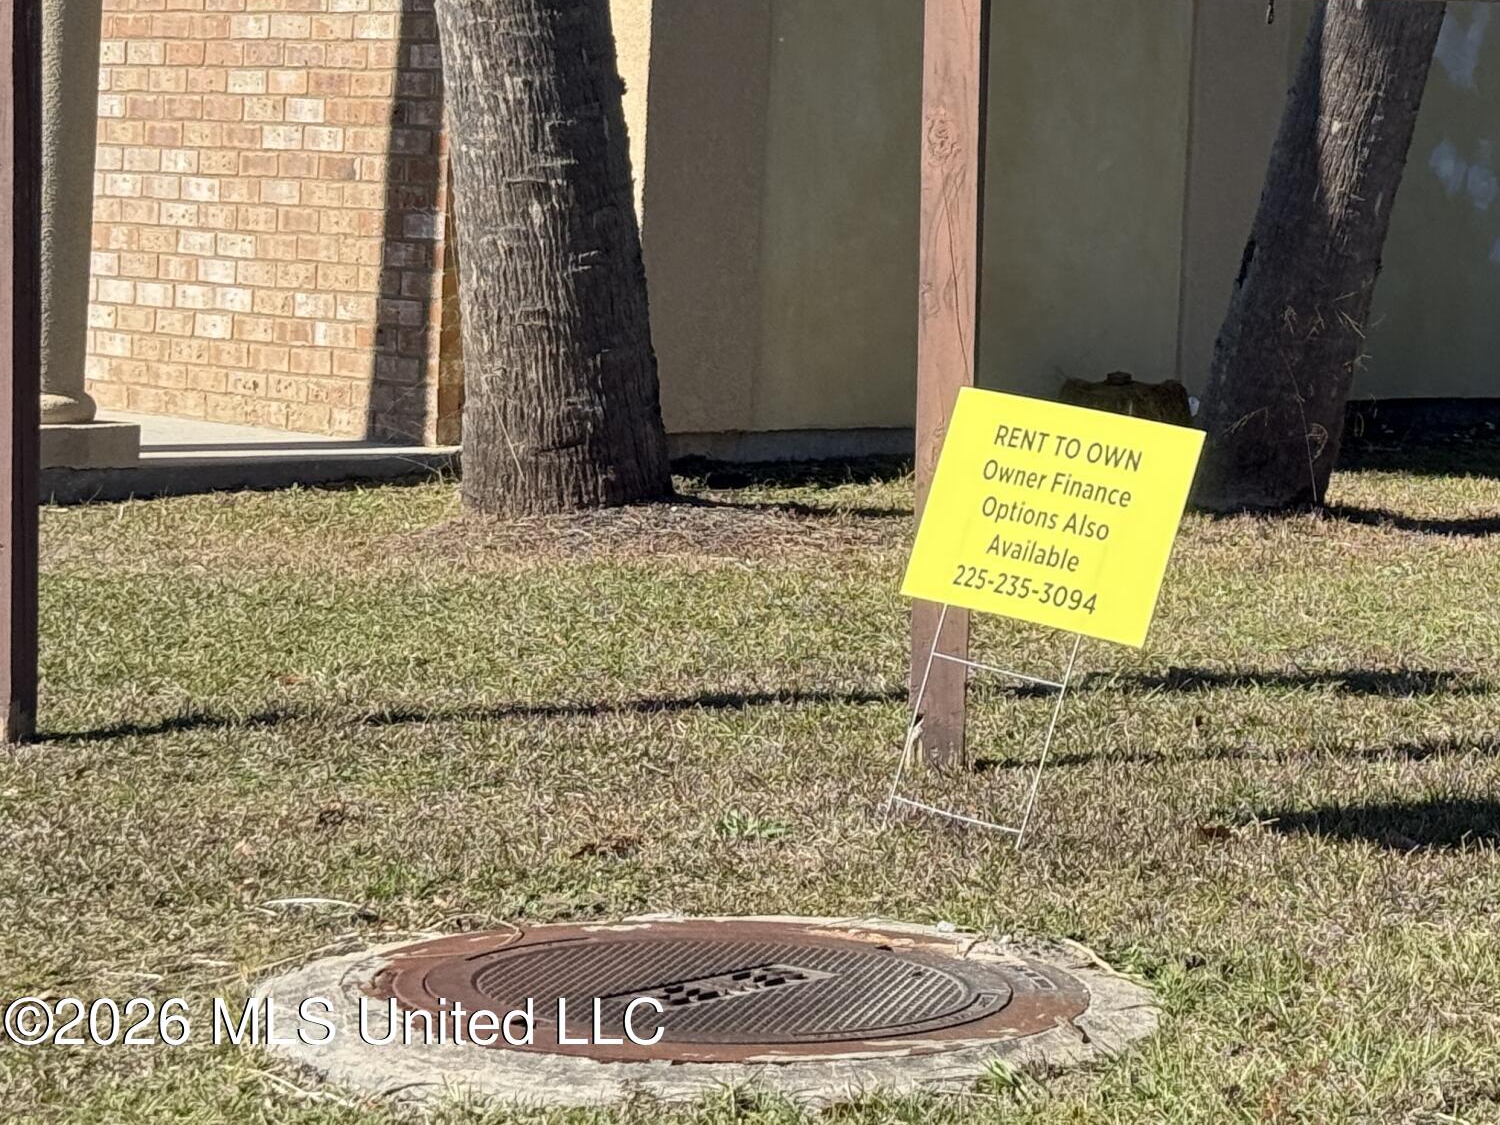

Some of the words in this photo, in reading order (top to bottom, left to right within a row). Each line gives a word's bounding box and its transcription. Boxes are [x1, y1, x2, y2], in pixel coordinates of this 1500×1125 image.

[993, 424, 1050, 454] RENT
[1054, 435, 1081, 460] TO
[1086, 442, 1143, 473] OWN
[983, 459, 1047, 491] Owner
[1050, 472, 1132, 508] Finance
[981, 495, 1059, 531] Options
[1061, 512, 1110, 541] Also
[985, 533, 1080, 573] Available
[952, 564, 1098, 616] 225-235-3094
